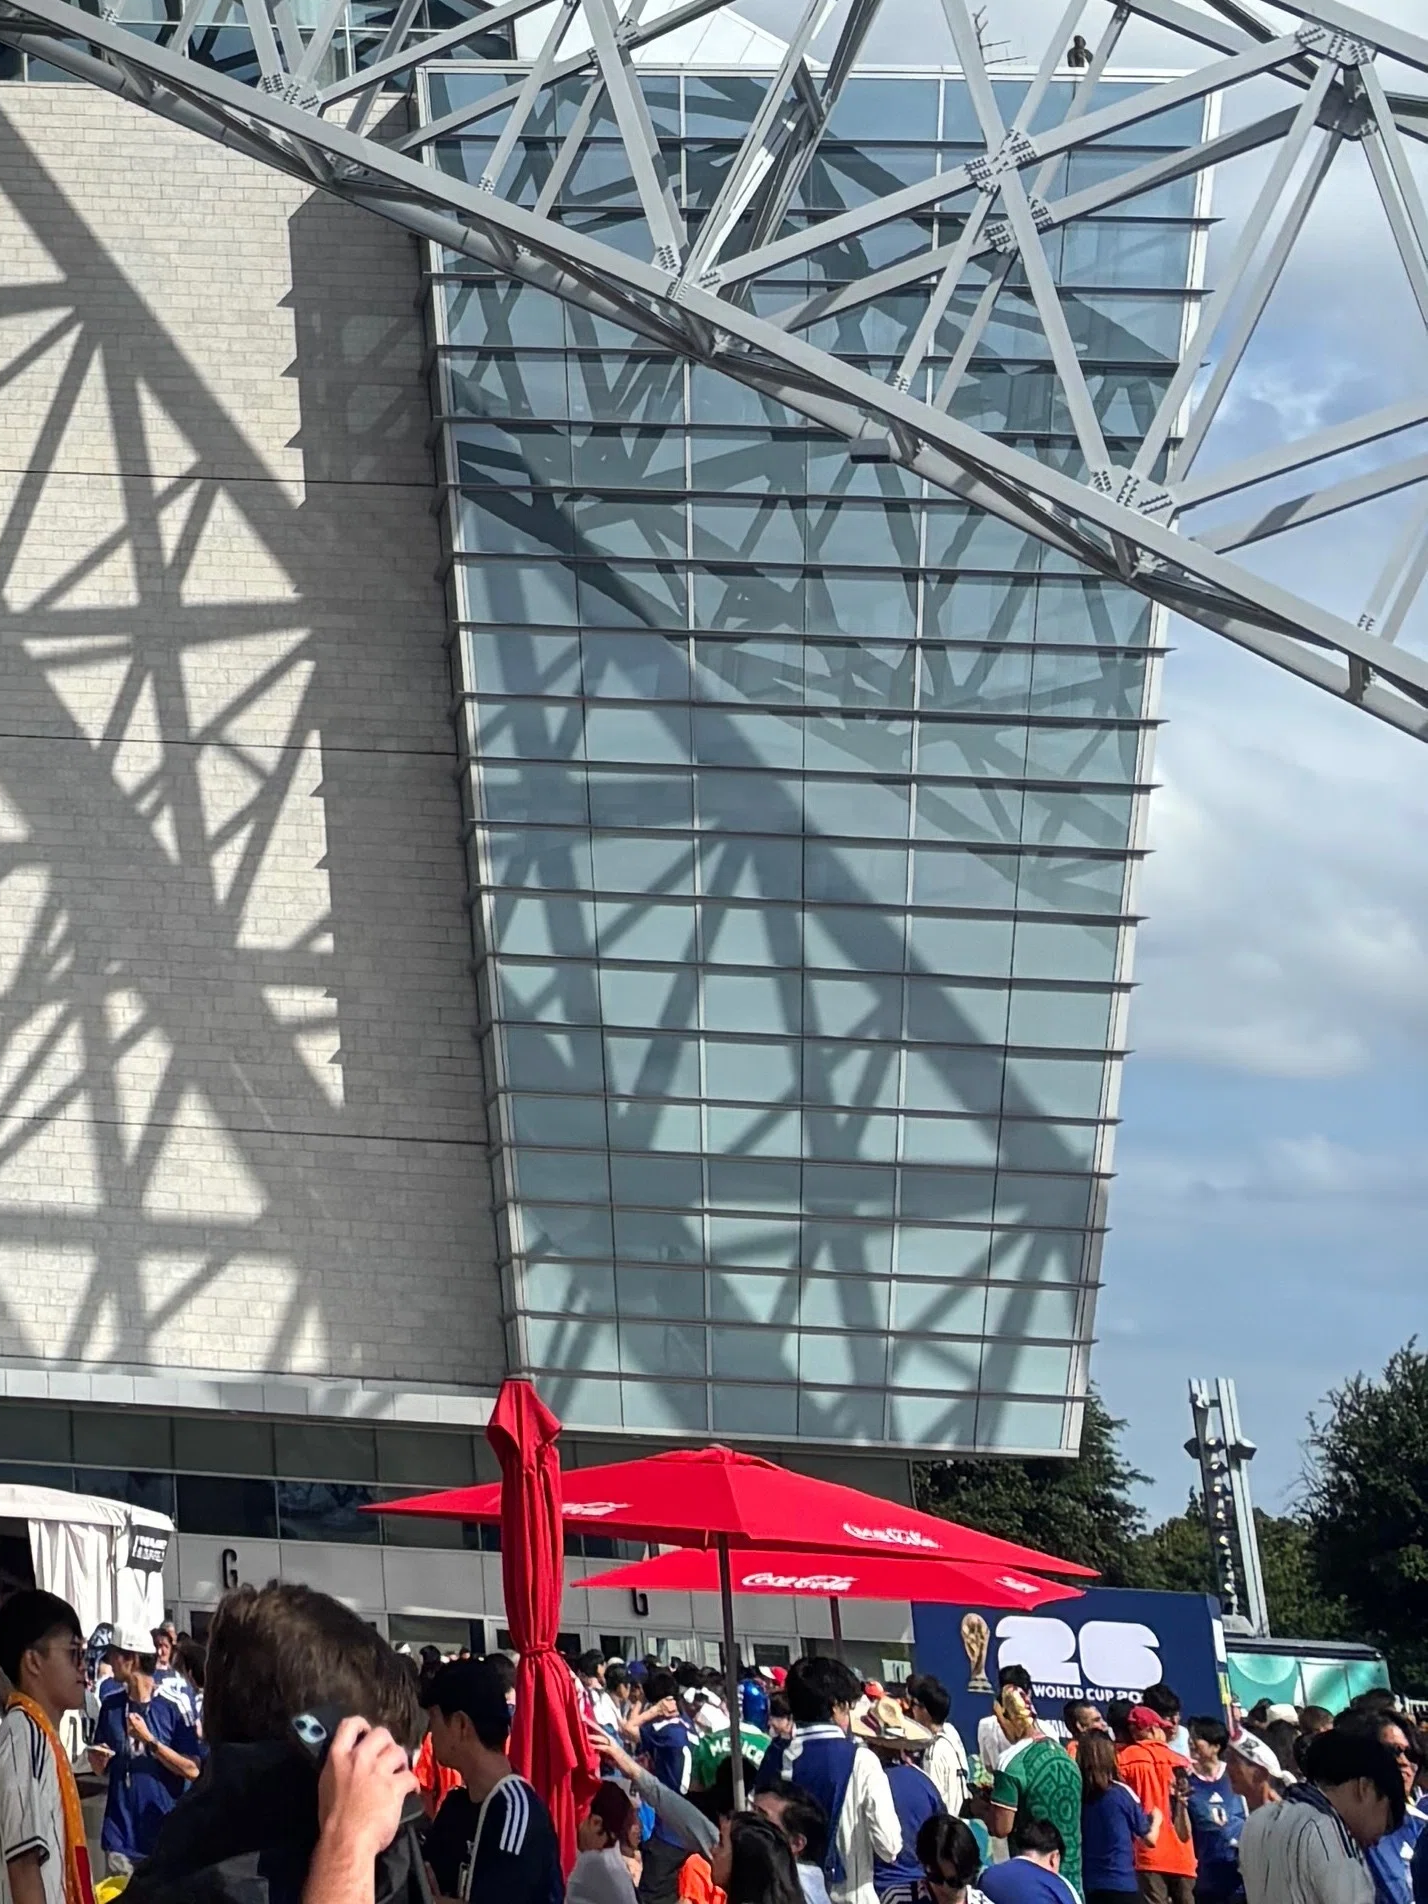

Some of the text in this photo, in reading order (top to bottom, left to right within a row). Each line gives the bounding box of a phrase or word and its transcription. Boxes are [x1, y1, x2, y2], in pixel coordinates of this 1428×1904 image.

[221, 1548, 239, 1589] G
[1033, 1684, 1143, 1705] WORLD CUP 20
[709, 1737, 765, 1772] MEICO
